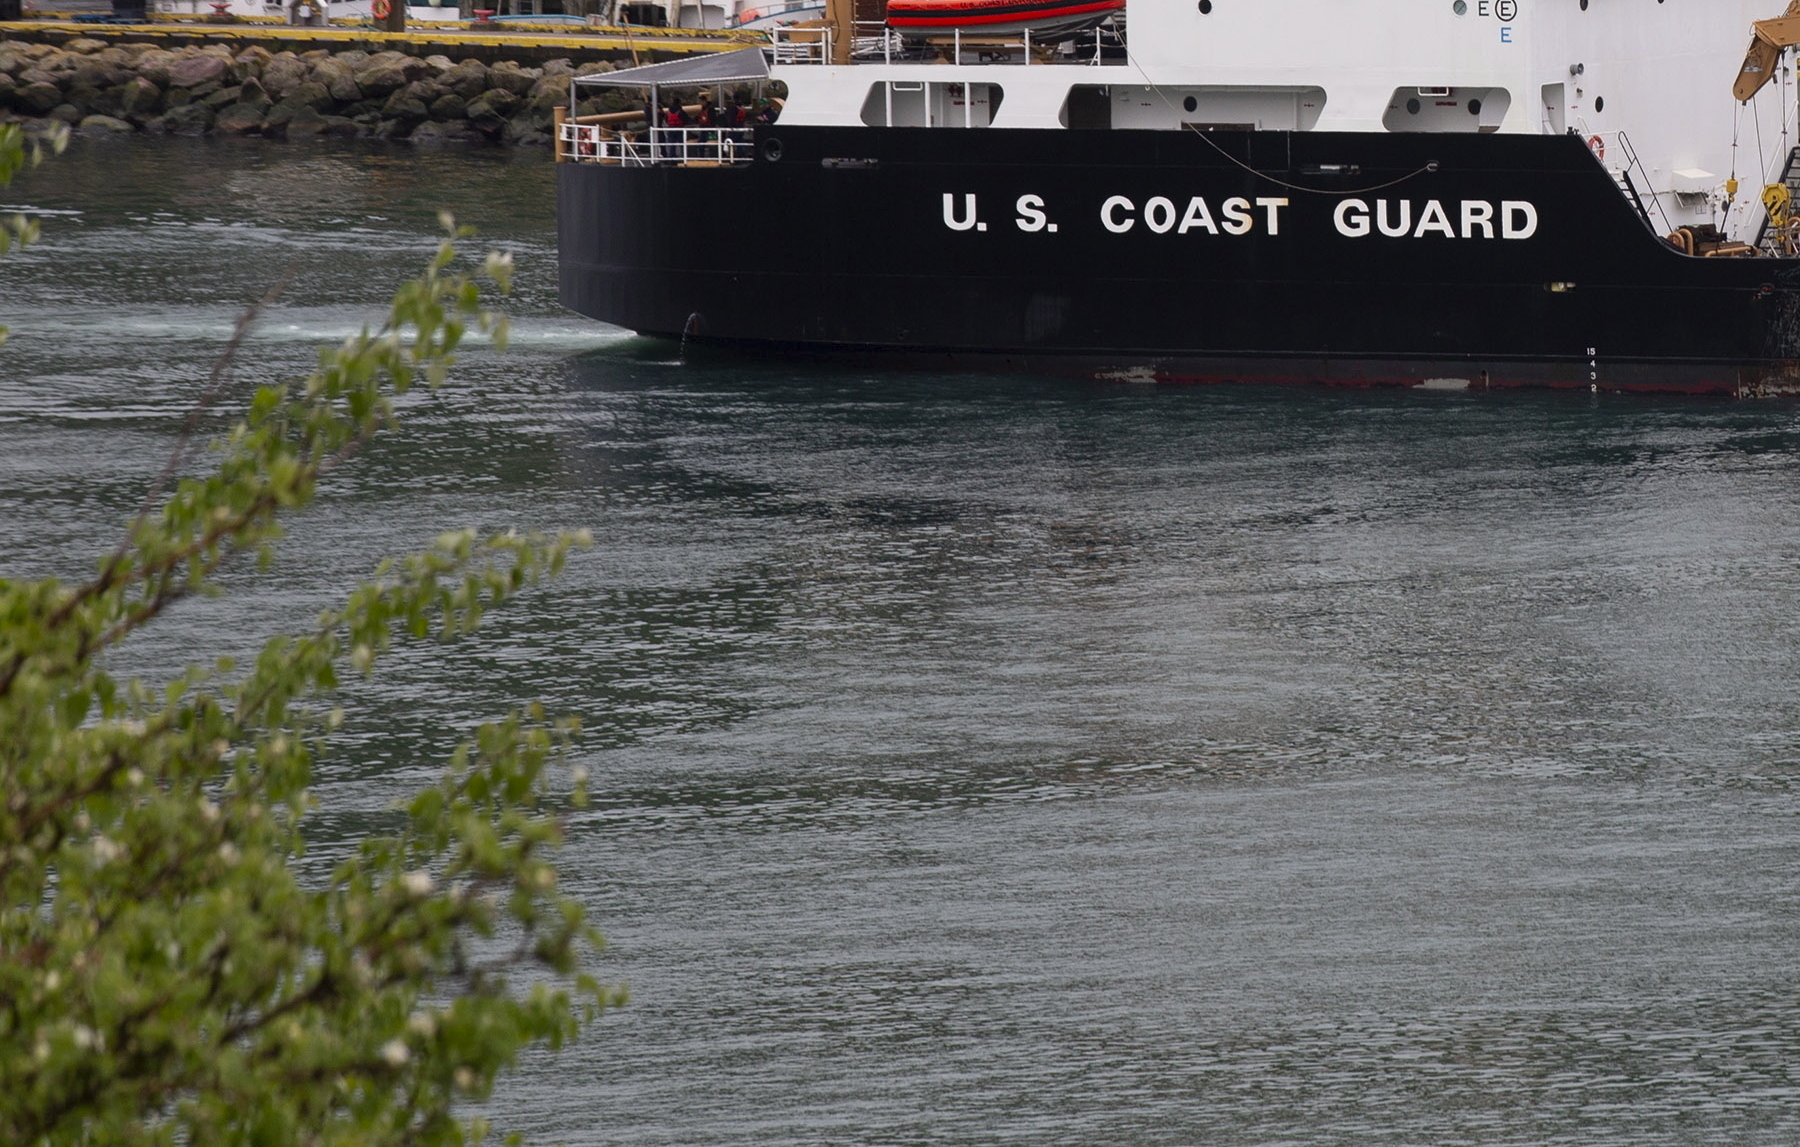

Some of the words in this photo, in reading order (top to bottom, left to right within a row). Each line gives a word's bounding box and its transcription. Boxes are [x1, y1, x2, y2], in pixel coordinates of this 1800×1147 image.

[1478, 1, 1489, 16] E
[1501, 1, 1511, 16] E
[1500, 27, 1512, 43] E
[942, 193, 988, 232] U.
[1015, 194, 1059, 233] S.
[1101, 195, 1289, 236] COAST
[1333, 198, 1538, 239] GUARD
[1586, 347, 1596, 355] 15
[1590, 371, 1596, 380] 3
[1591, 384, 1597, 393] 2
